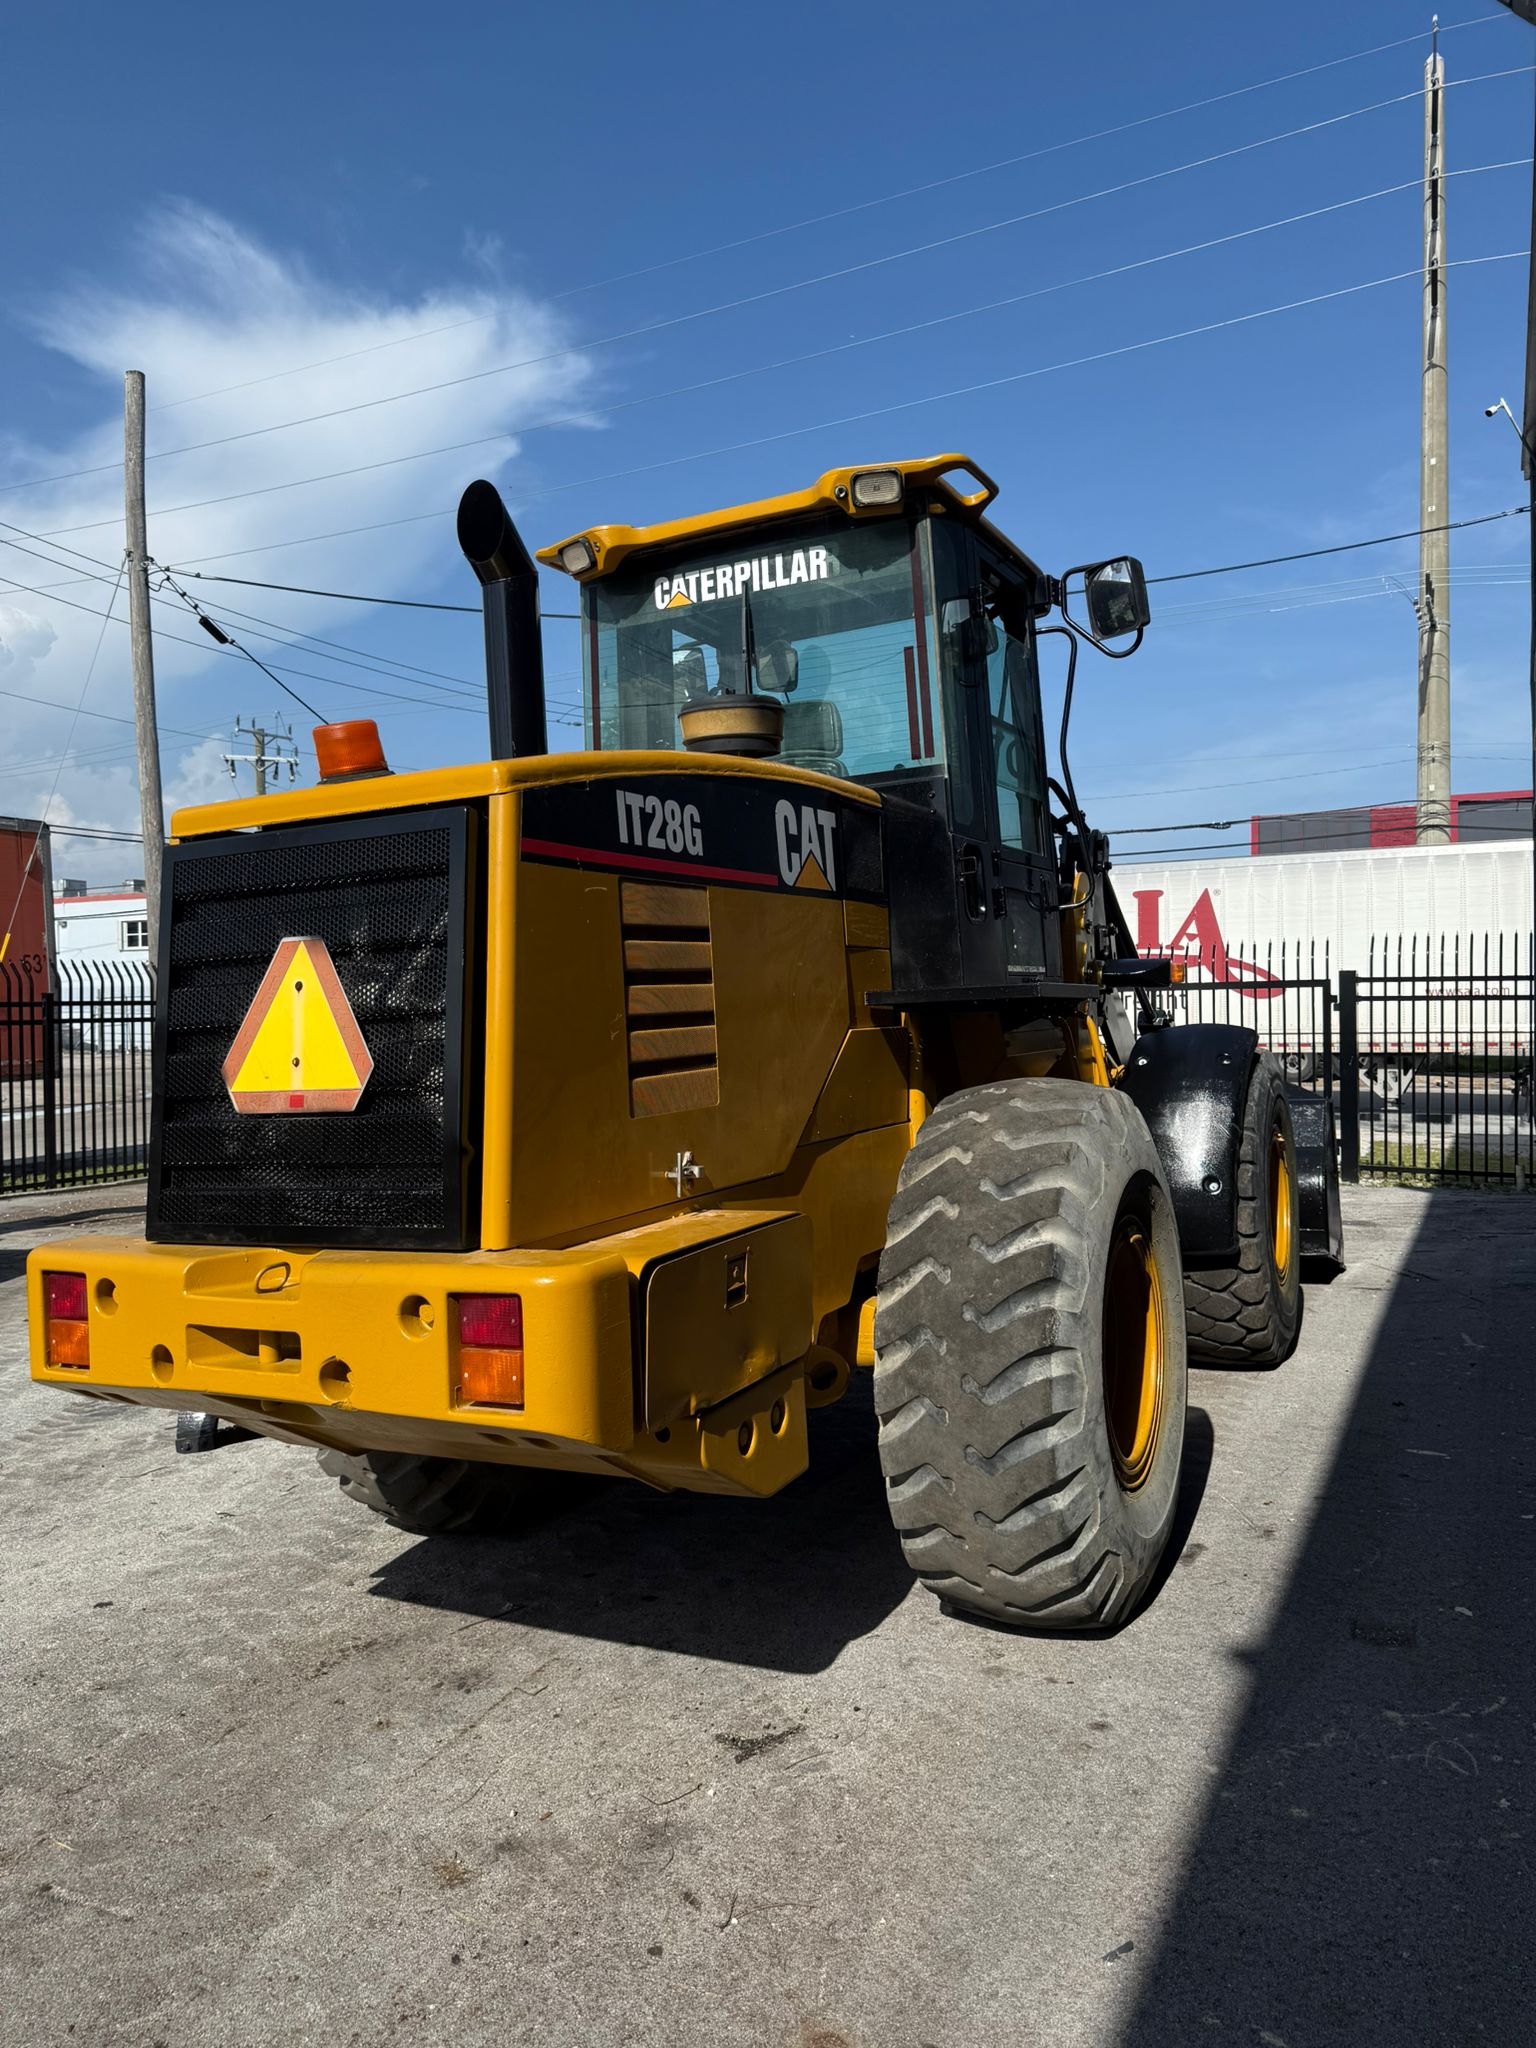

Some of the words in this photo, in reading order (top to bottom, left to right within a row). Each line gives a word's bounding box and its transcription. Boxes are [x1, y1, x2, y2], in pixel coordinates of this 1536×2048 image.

[655, 545, 828, 609] CATERPILLAR
[615, 789, 704, 857] IT28G
[775, 799, 836, 892] CAT
